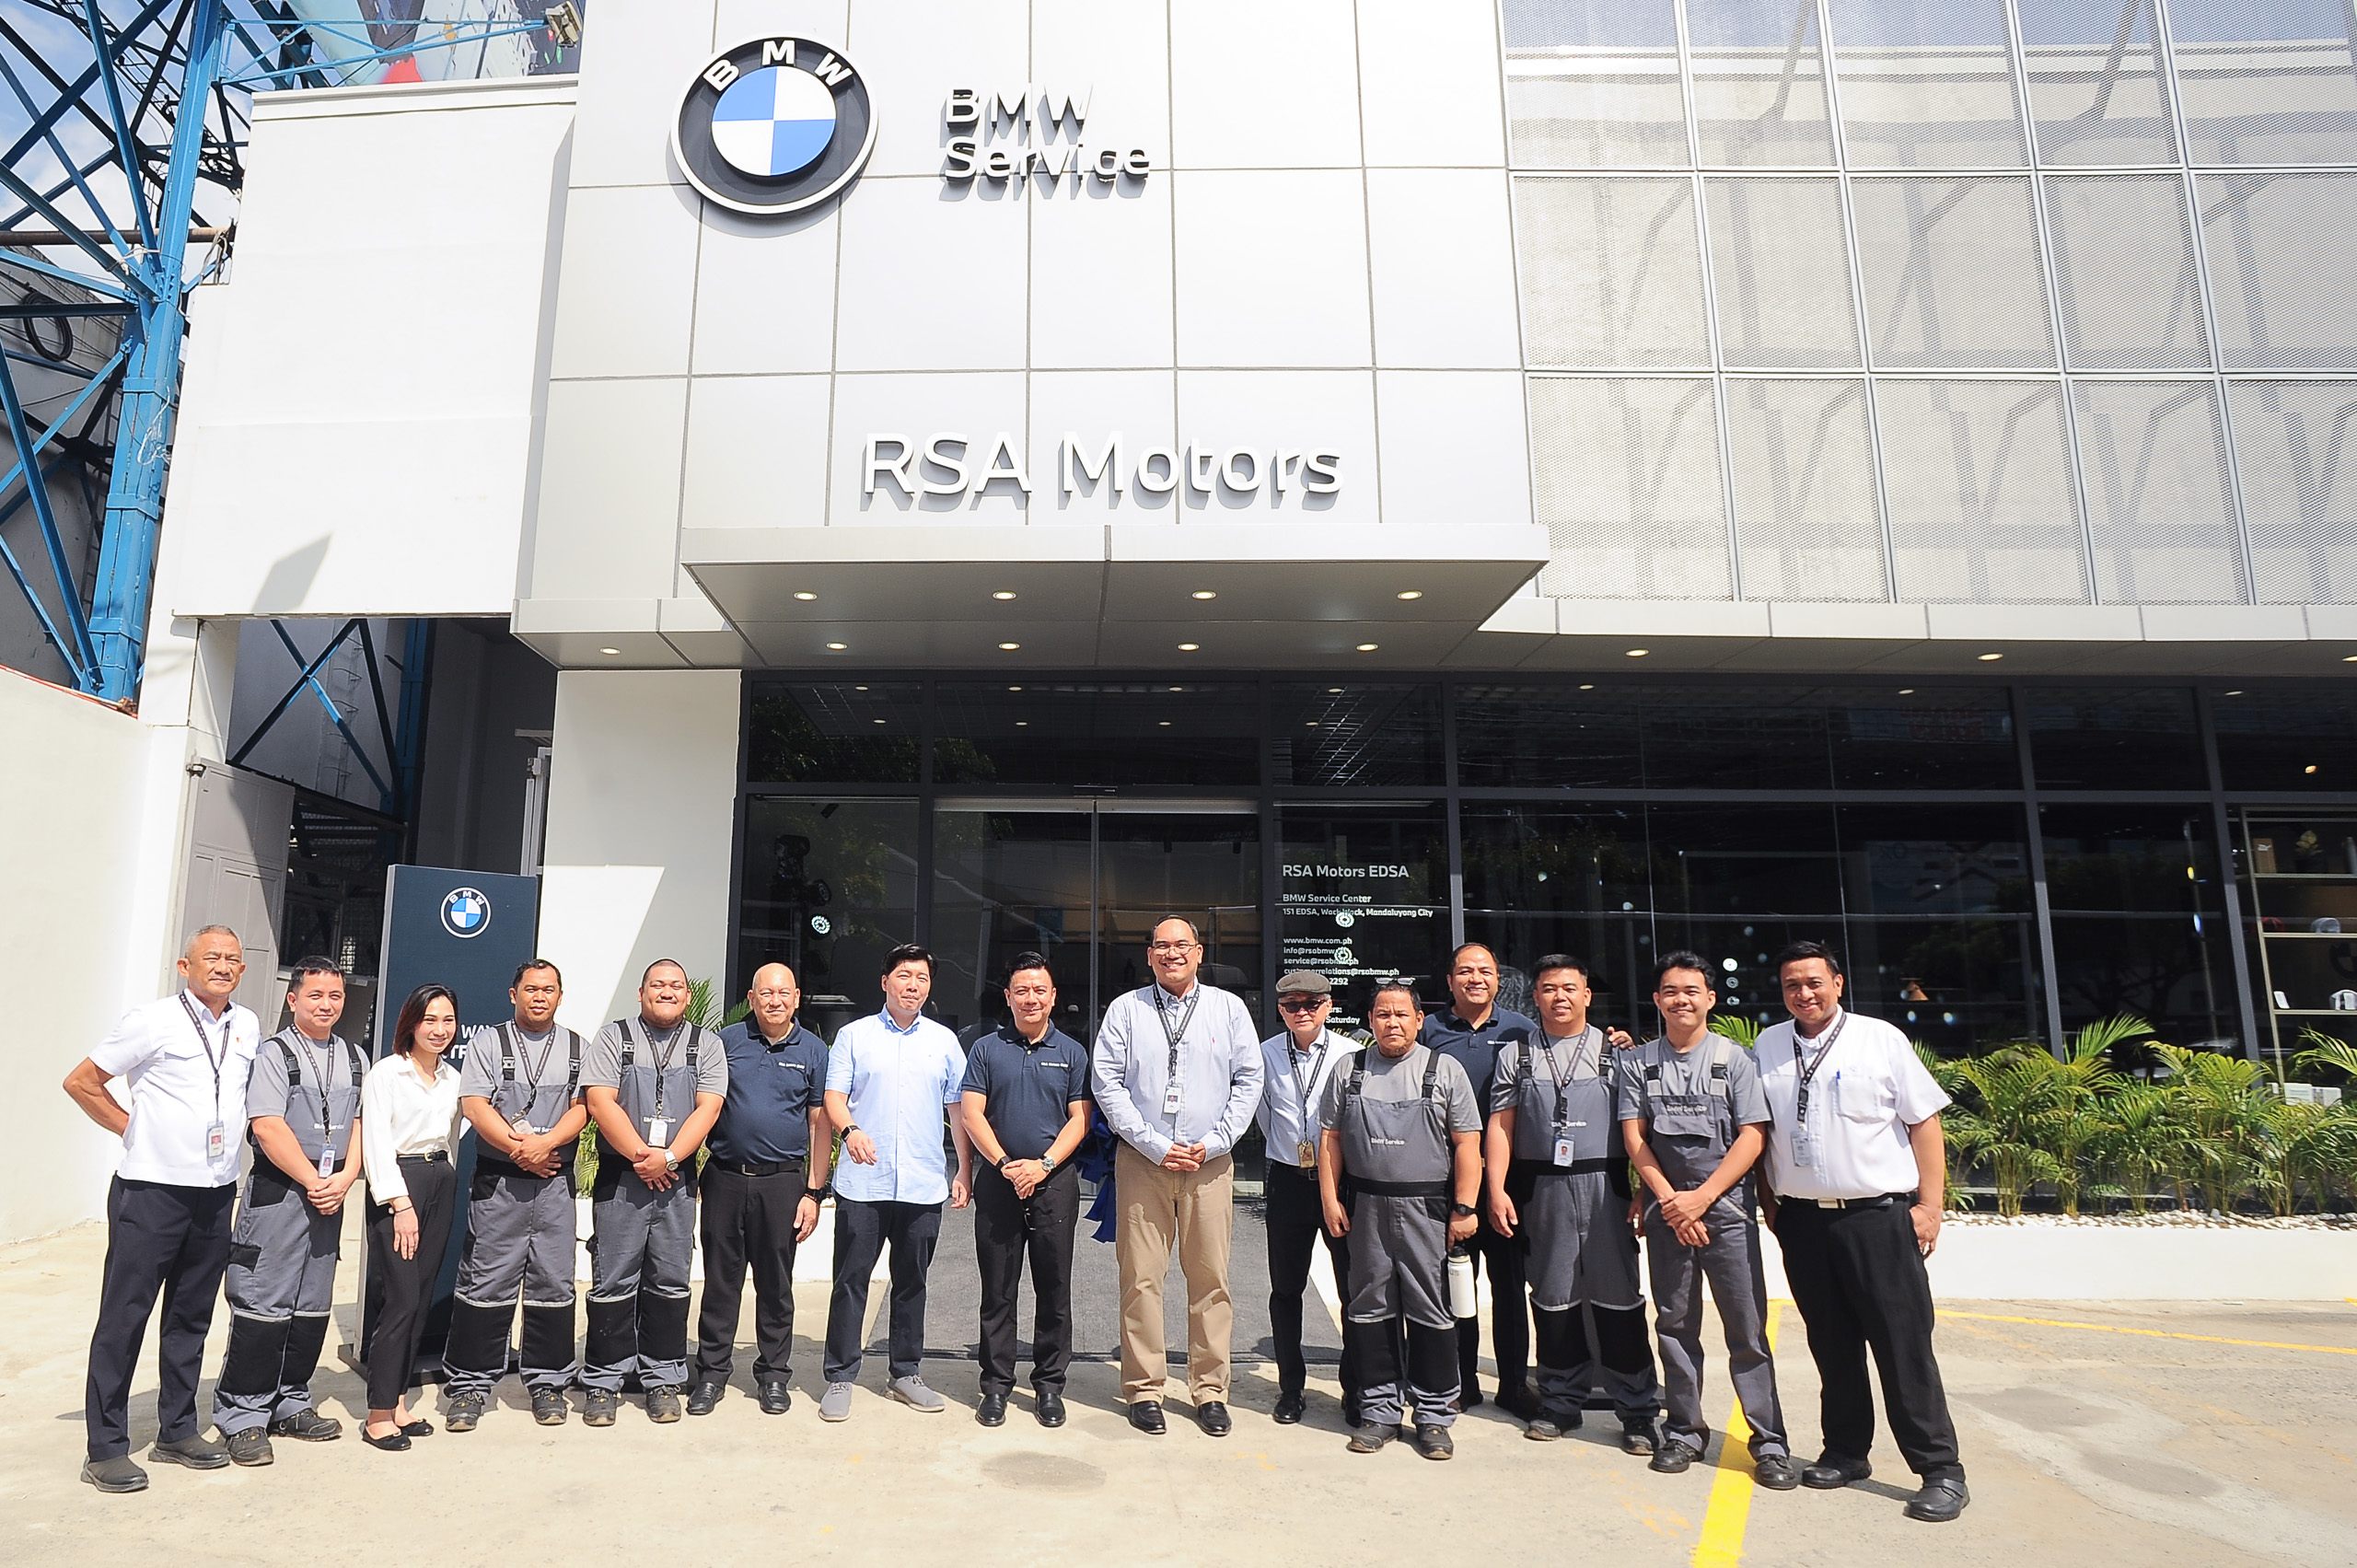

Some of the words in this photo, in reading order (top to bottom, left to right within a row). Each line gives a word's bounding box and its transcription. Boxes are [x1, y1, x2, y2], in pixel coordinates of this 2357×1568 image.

[702, 40, 853, 91] BMW
[944, 82, 1093, 127] BMW
[943, 135, 1151, 182] Service
[863, 431, 1032, 495] RSA
[1062, 430, 1344, 494] Motors
[1282, 865, 1313, 877] RSA
[1316, 865, 1365, 878] Motors
[1368, 865, 1410, 878] EDSA
[448, 890, 485, 906] BMW
[1283, 893, 1306, 902] BMW
[1307, 894, 1341, 903] Service
[1341, 894, 1373, 903] Center
[1295, 908, 1319, 916] EDSA,
[1366, 908, 1417, 918] Mandaluyong
[1418, 908, 1434, 918] City
[1283, 936, 1353, 946] www.bmw.com.ph
[1326, 1016, 1361, 1026] Saturday
